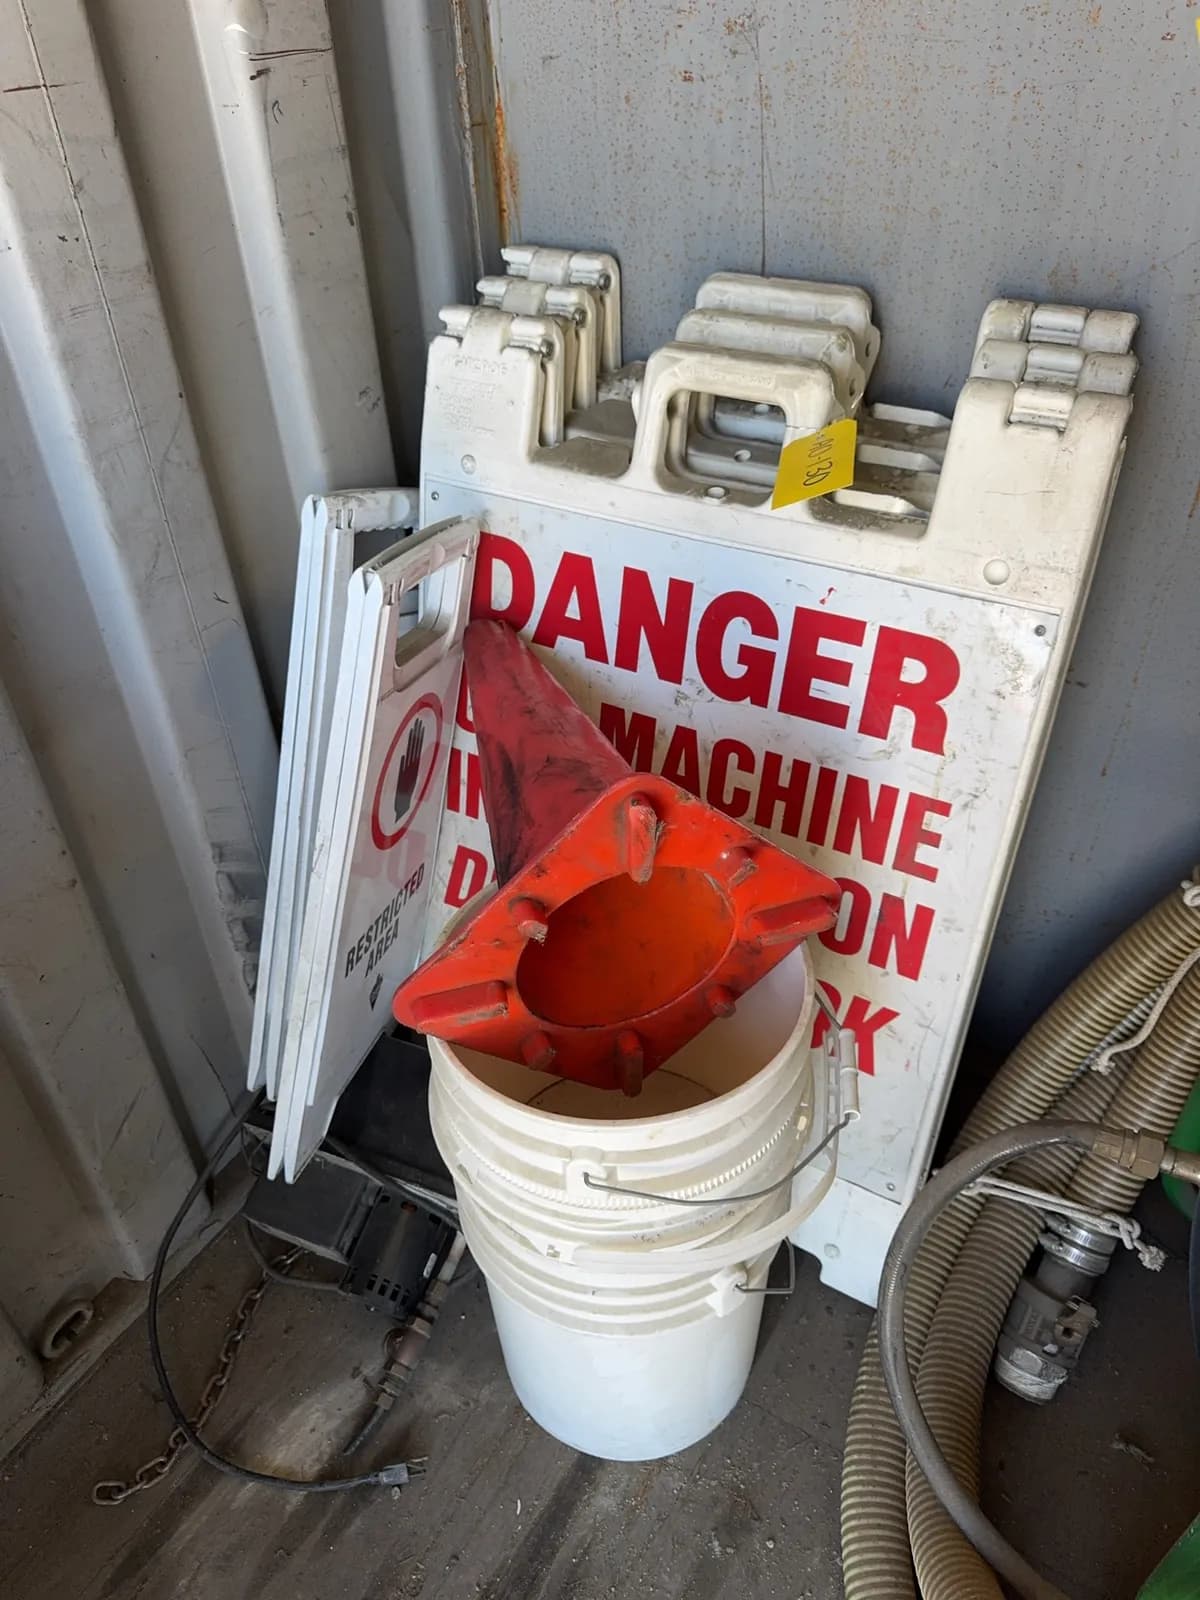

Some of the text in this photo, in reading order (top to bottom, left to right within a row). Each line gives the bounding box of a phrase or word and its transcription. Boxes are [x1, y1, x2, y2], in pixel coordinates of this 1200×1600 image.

[469, 531, 961, 756] DANGER
[600, 702, 953, 883] MACHINE
[345, 863, 425, 978] RESTRICTED
[365, 918, 400, 978] AREA
